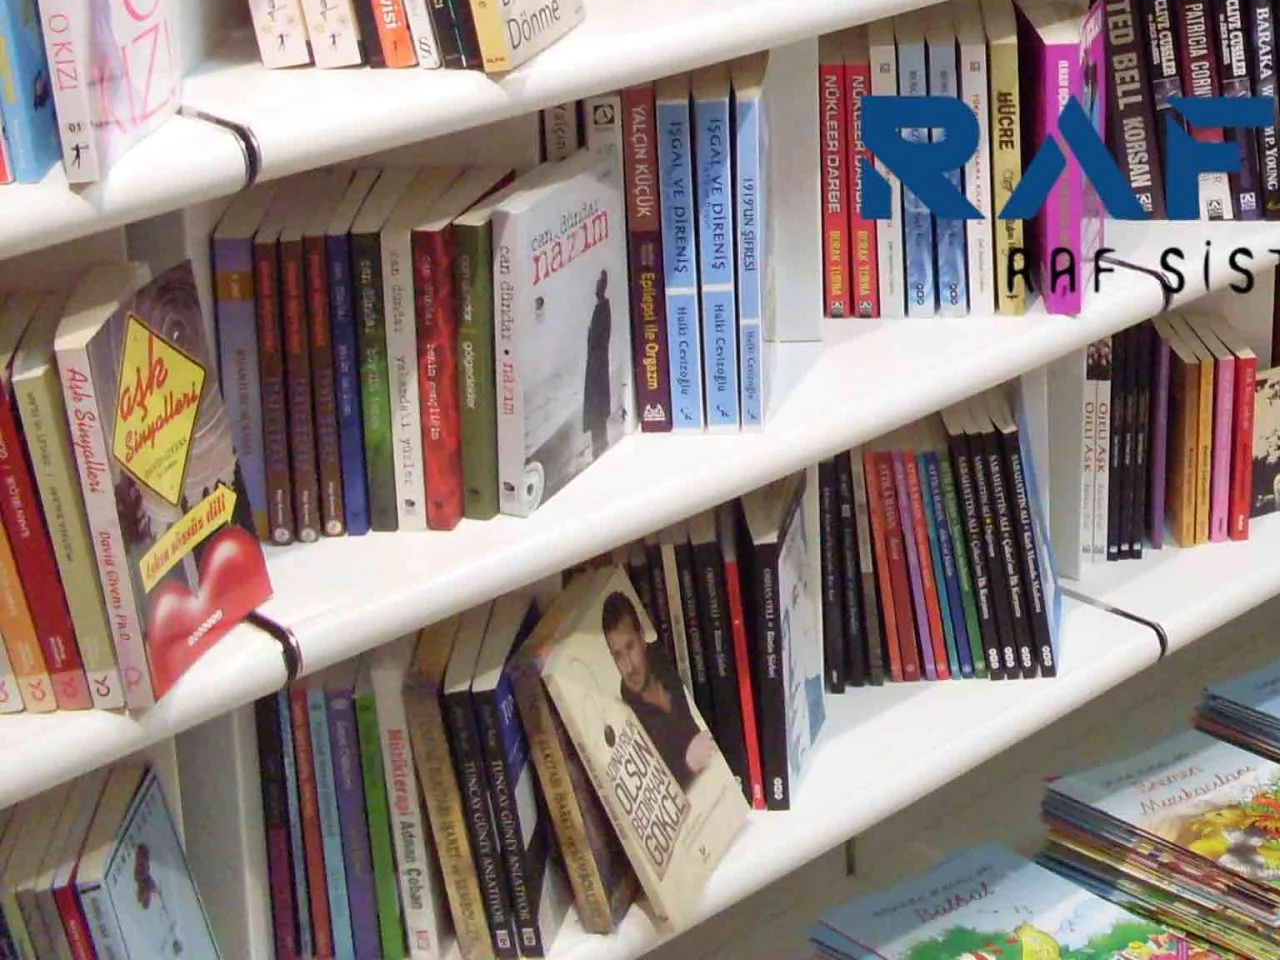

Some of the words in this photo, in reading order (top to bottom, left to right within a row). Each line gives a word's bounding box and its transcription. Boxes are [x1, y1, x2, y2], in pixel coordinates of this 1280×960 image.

[1158, 31, 1177, 77] CUSSLER
[1184, 2, 1209, 58] PATRICIA
[1230, 32, 1247, 77] CUSSLER
[1256, 7, 1274, 80] BARAKA
[1112, 52, 1143, 111] BELL
[630, 105, 648, 161] YALÇIN
[1122, 117, 1152, 188] KORSAN
[672, 177, 685, 199] VE
[711, 172, 723, 195] VE
[499, 245, 511, 275] can
[640, 272, 656, 324] Epilepsi
[122, 380, 201, 465] Sinyalleri
[614, 733, 660, 818] OLSUN
